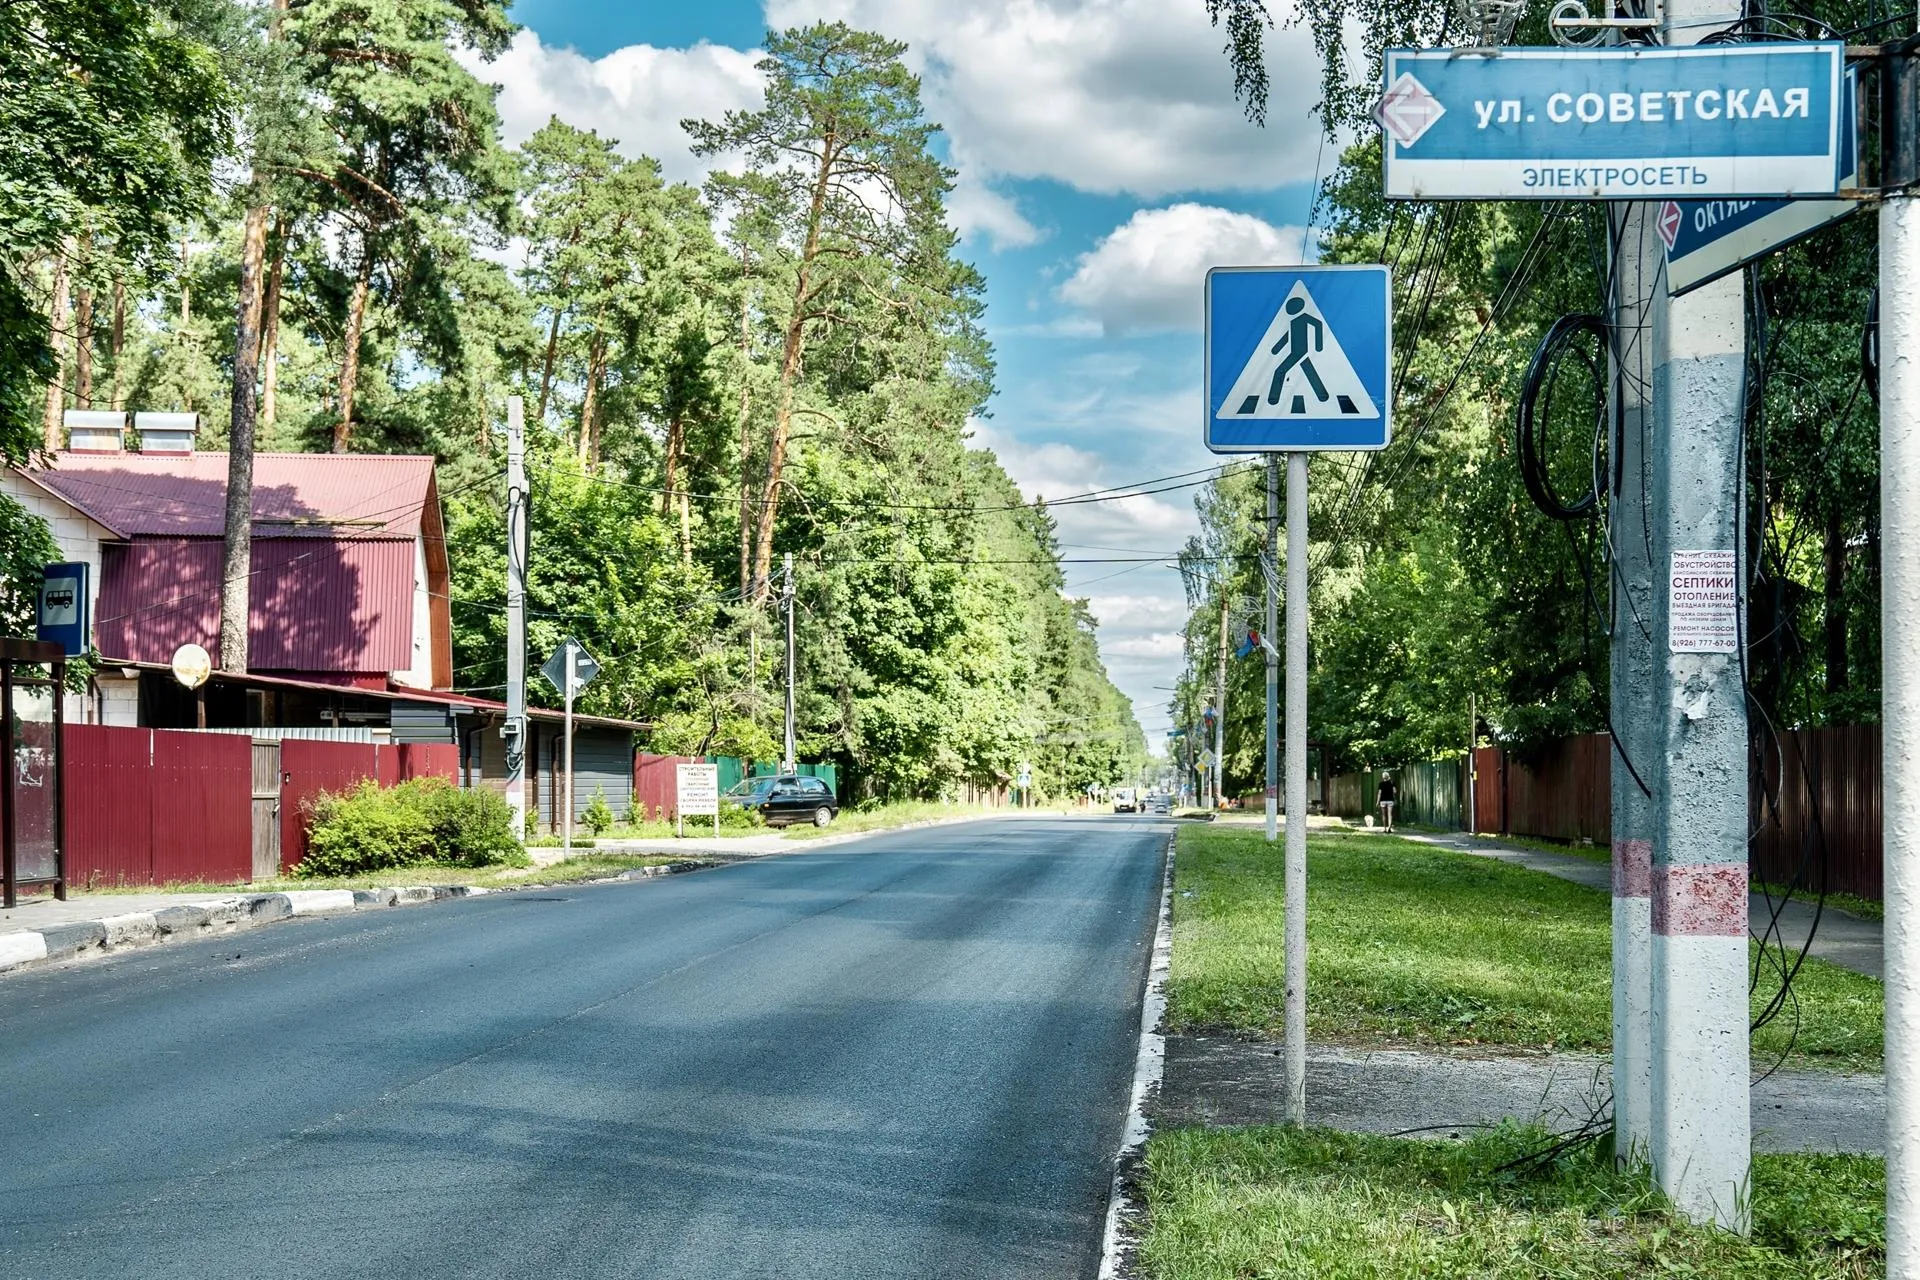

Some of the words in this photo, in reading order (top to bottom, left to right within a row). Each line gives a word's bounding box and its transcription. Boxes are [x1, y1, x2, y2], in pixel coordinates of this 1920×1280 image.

[1475, 98, 1534, 129] ул.
[1547, 87, 1810, 124] СОВЕТСКАЯ
[1522, 166, 1708, 188] ЭЛЕКТРОСЕТЬ
[1672, 577, 1734, 588] СЕПТИКИ
[1674, 592, 1735, 601] ОТОПЛЕНИЕ
[1672, 639, 1696, 647] 8(926)
[1699, 639, 1736, 647] 777-67-00
